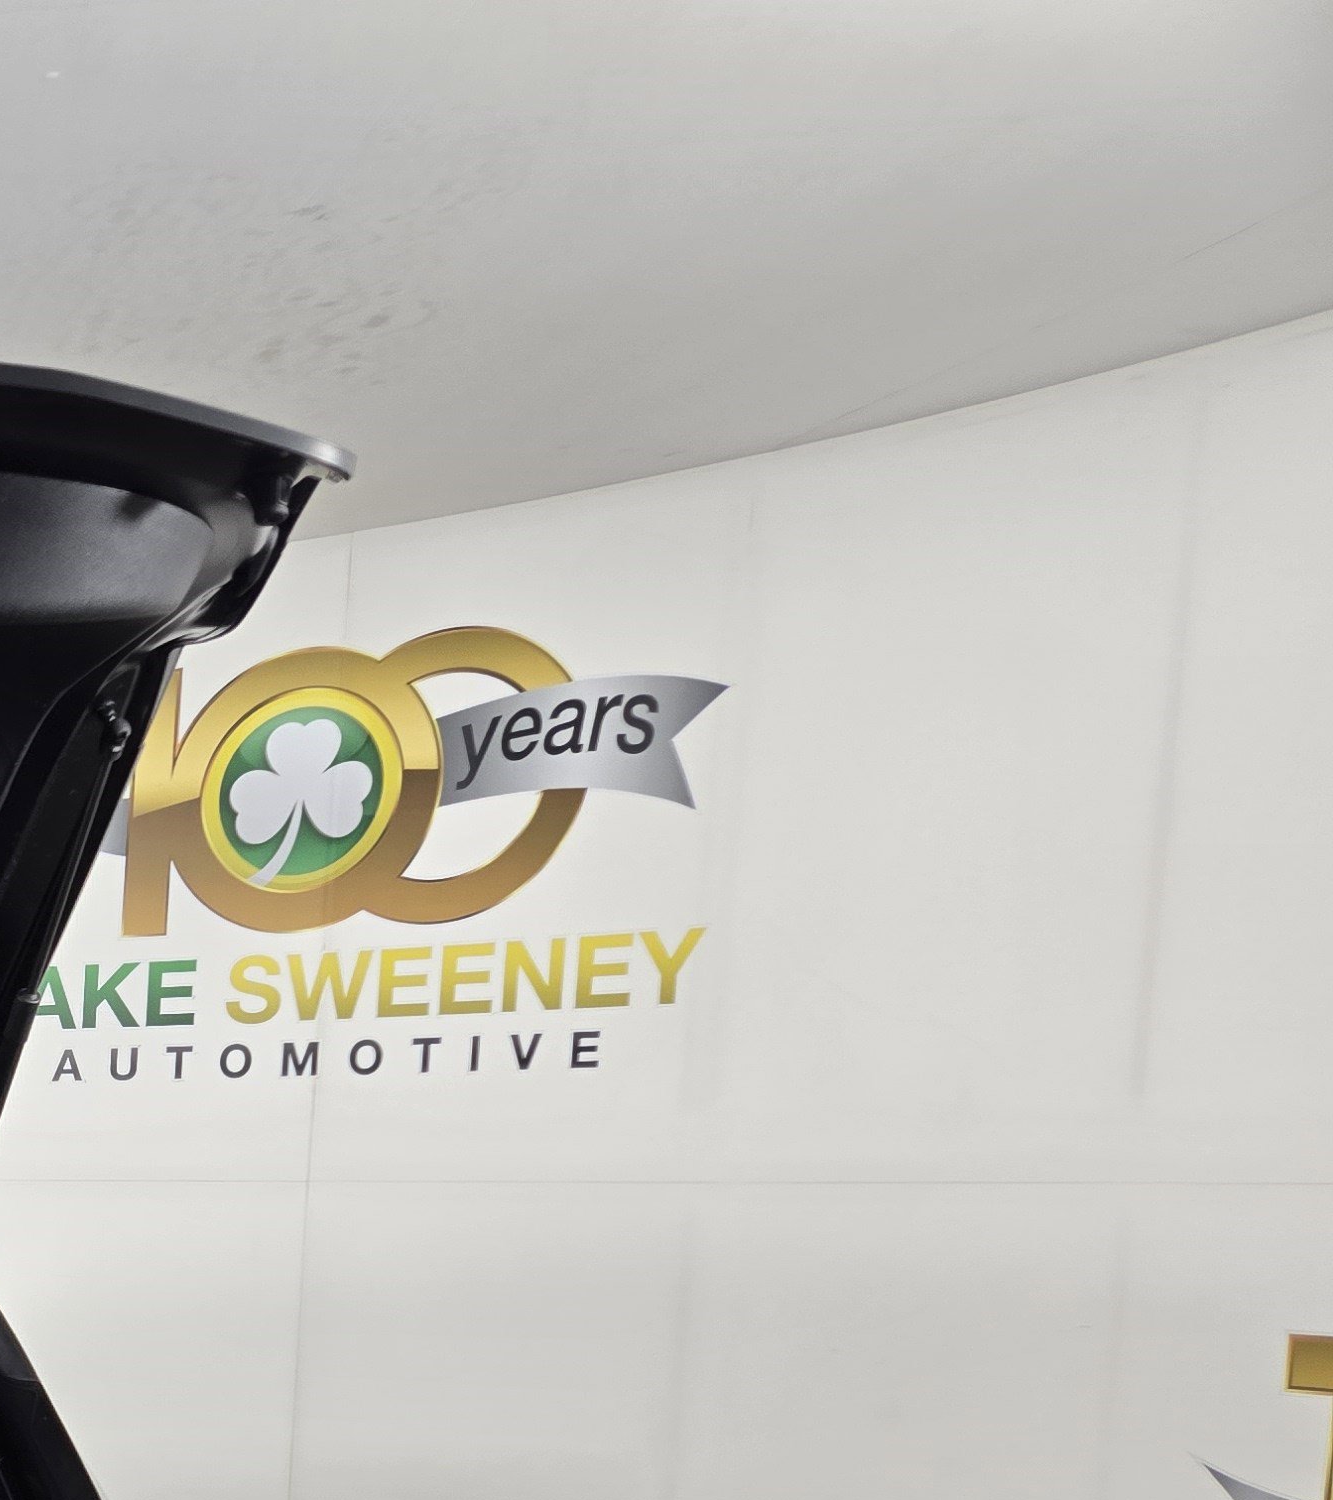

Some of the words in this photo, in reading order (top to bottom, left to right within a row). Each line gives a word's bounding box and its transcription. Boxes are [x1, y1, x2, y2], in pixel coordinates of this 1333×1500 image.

[455, 692, 659, 790] years
[36, 959, 197, 1030] AKE
[225, 927, 706, 1026] SWEENEY
[51, 1030, 601, 1082] AUTOMOTIVE
